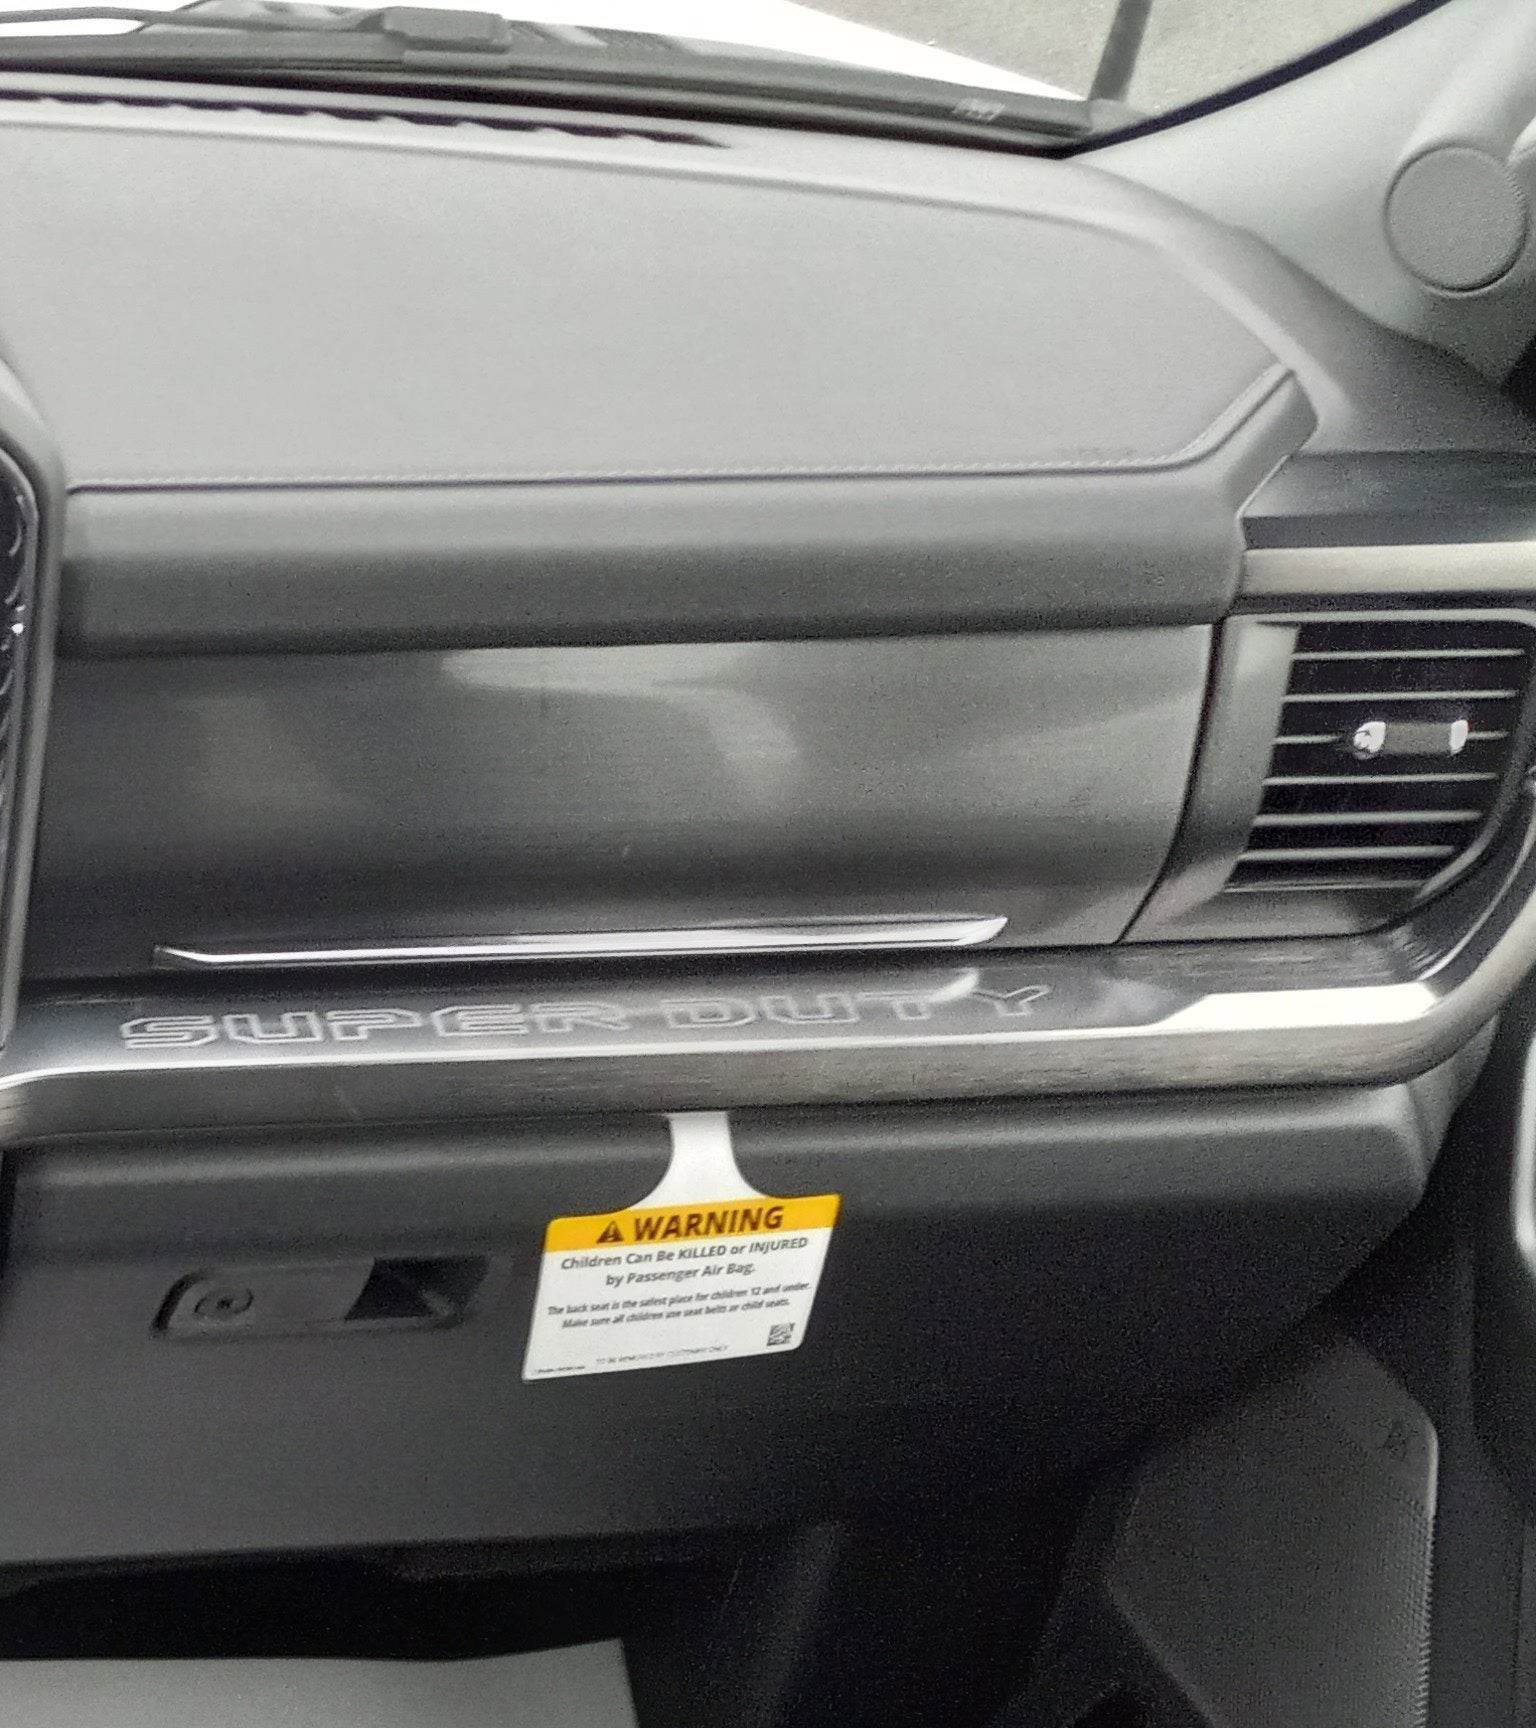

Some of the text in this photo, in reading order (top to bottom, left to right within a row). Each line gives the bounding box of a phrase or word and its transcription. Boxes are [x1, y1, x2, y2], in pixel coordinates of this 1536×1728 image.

[119, 984, 1051, 1050] SUPER DUTY
[634, 1206, 785, 1241] WARNING
[561, 1237, 808, 1270] Children Can Be KILLED or INJURED
[605, 1262, 756, 1288] by Passenger Air Bag.
[547, 1305, 565, 1316] The
[566, 1302, 588, 1314] back
[590, 1301, 610, 1312] seat
[611, 1301, 620, 1311] is
[622, 1299, 637, 1310] the
[668, 1294, 693, 1308] place
[695, 1291, 710, 1302] for
[711, 1288, 748, 1301] children
[763, 1284, 781, 1296] and
[626, 1310, 664, 1323] children
[683, 1306, 703, 1318] seat
[741, 1299, 764, 1312] child
